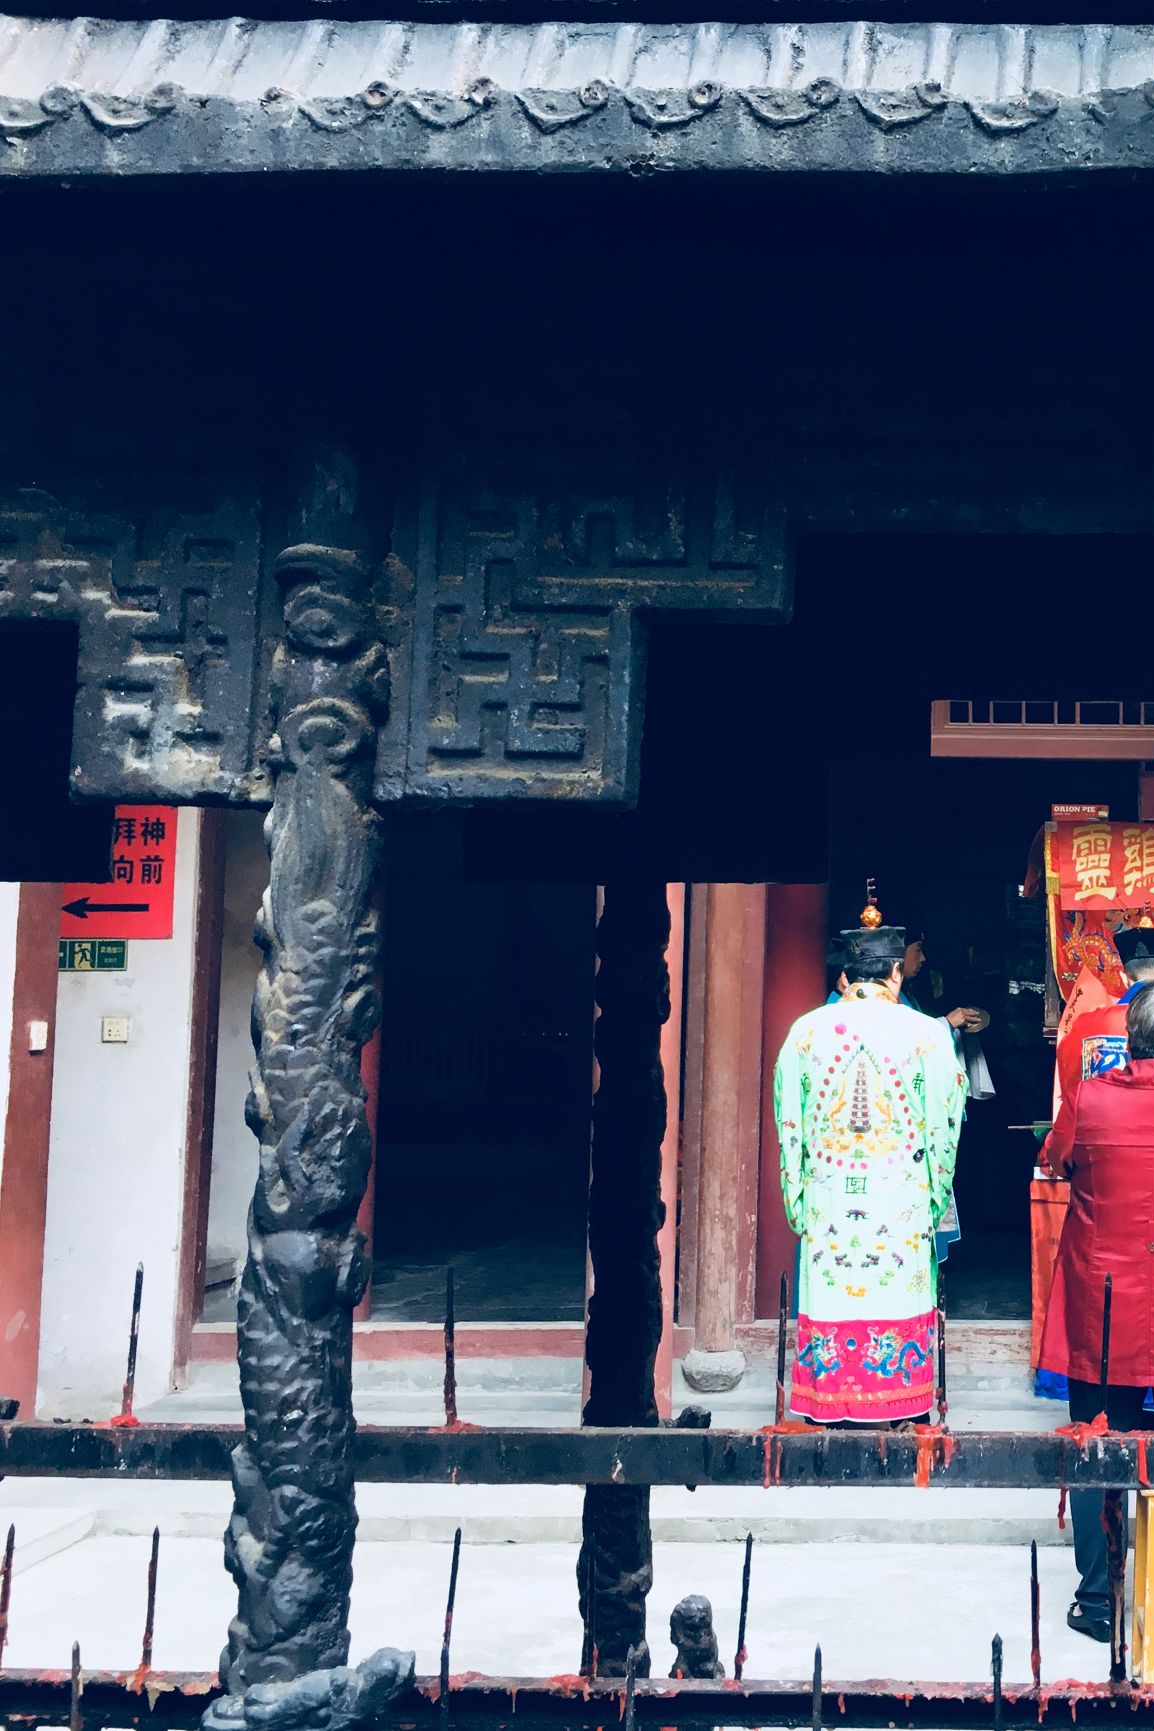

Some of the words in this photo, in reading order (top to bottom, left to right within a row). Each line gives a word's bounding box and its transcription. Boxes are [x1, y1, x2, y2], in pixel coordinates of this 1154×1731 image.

[1053, 805, 1080, 813] ORION
[1082, 805, 1096, 813] PIE
[113, 855, 165, 885] 向前
